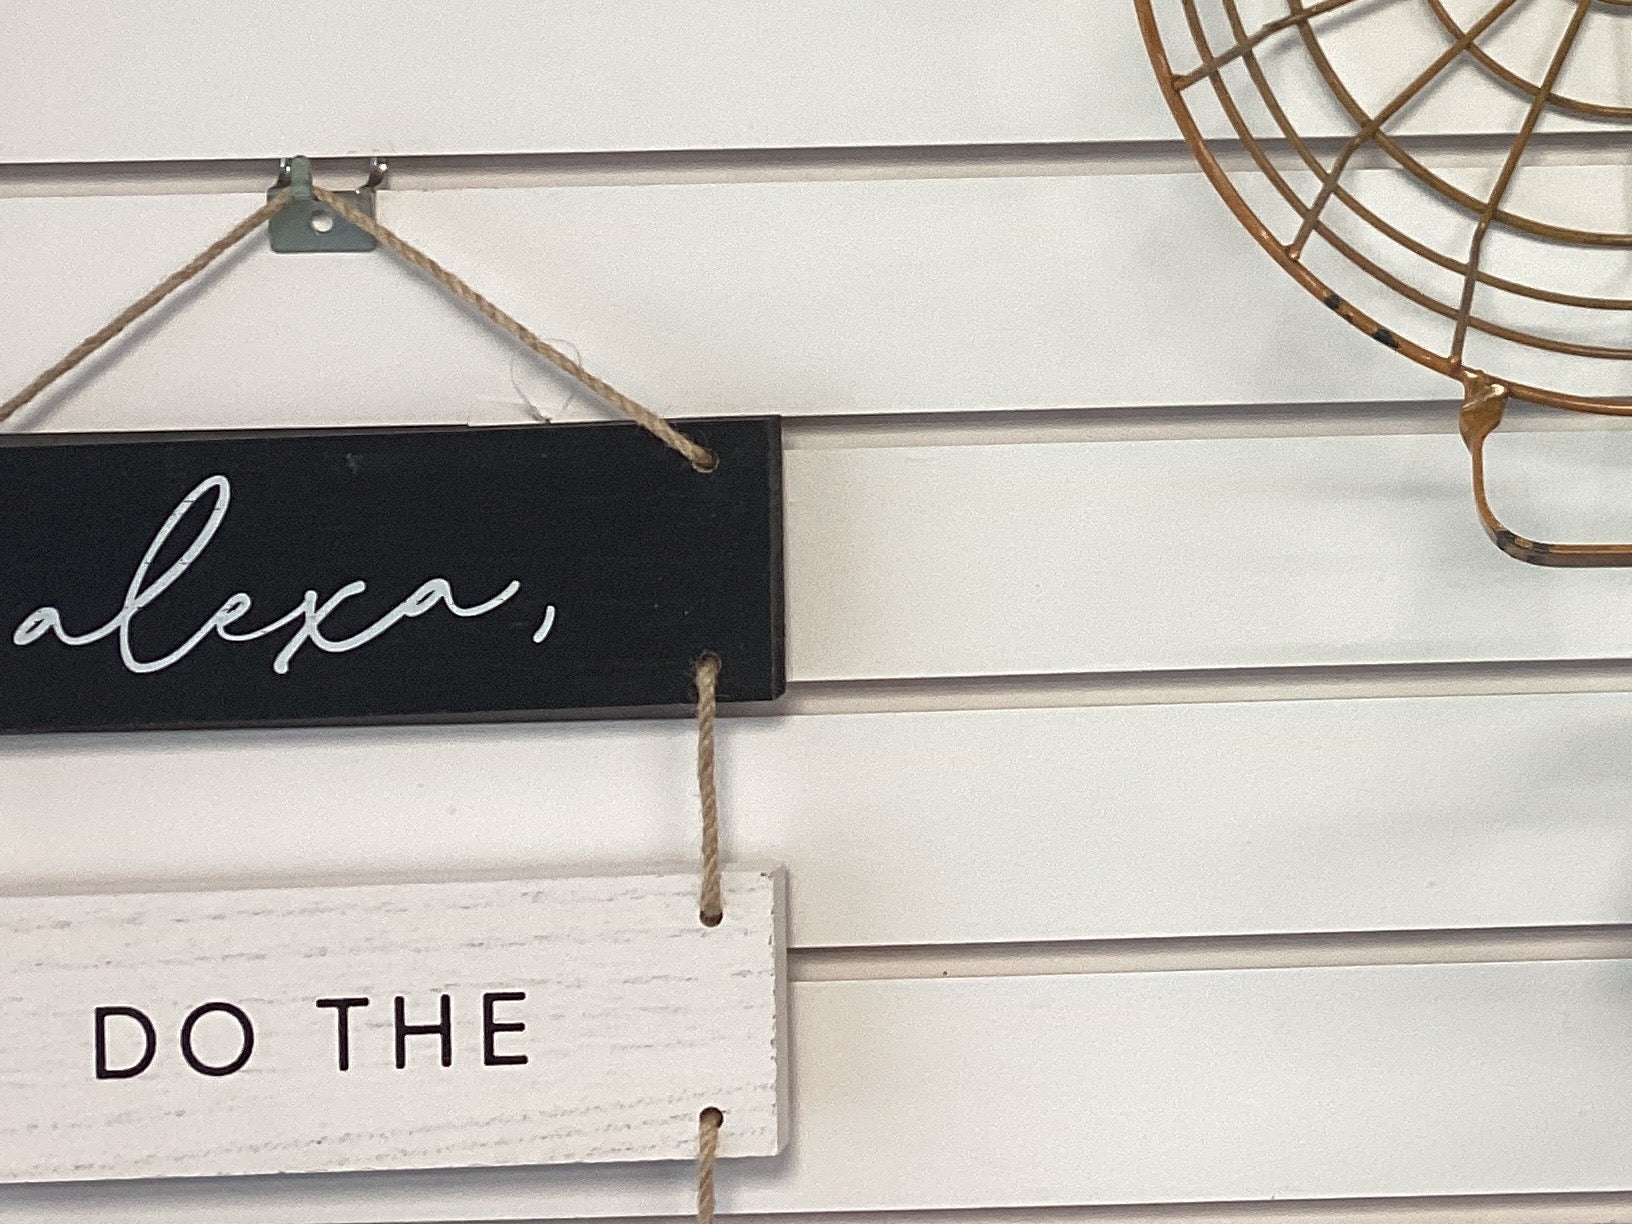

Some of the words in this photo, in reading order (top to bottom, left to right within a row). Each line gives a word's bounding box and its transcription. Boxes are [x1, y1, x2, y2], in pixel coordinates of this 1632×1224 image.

[12, 474, 557, 674] alexa,
[94, 1002, 255, 1079] DO
[316, 992, 529, 1072] THE
